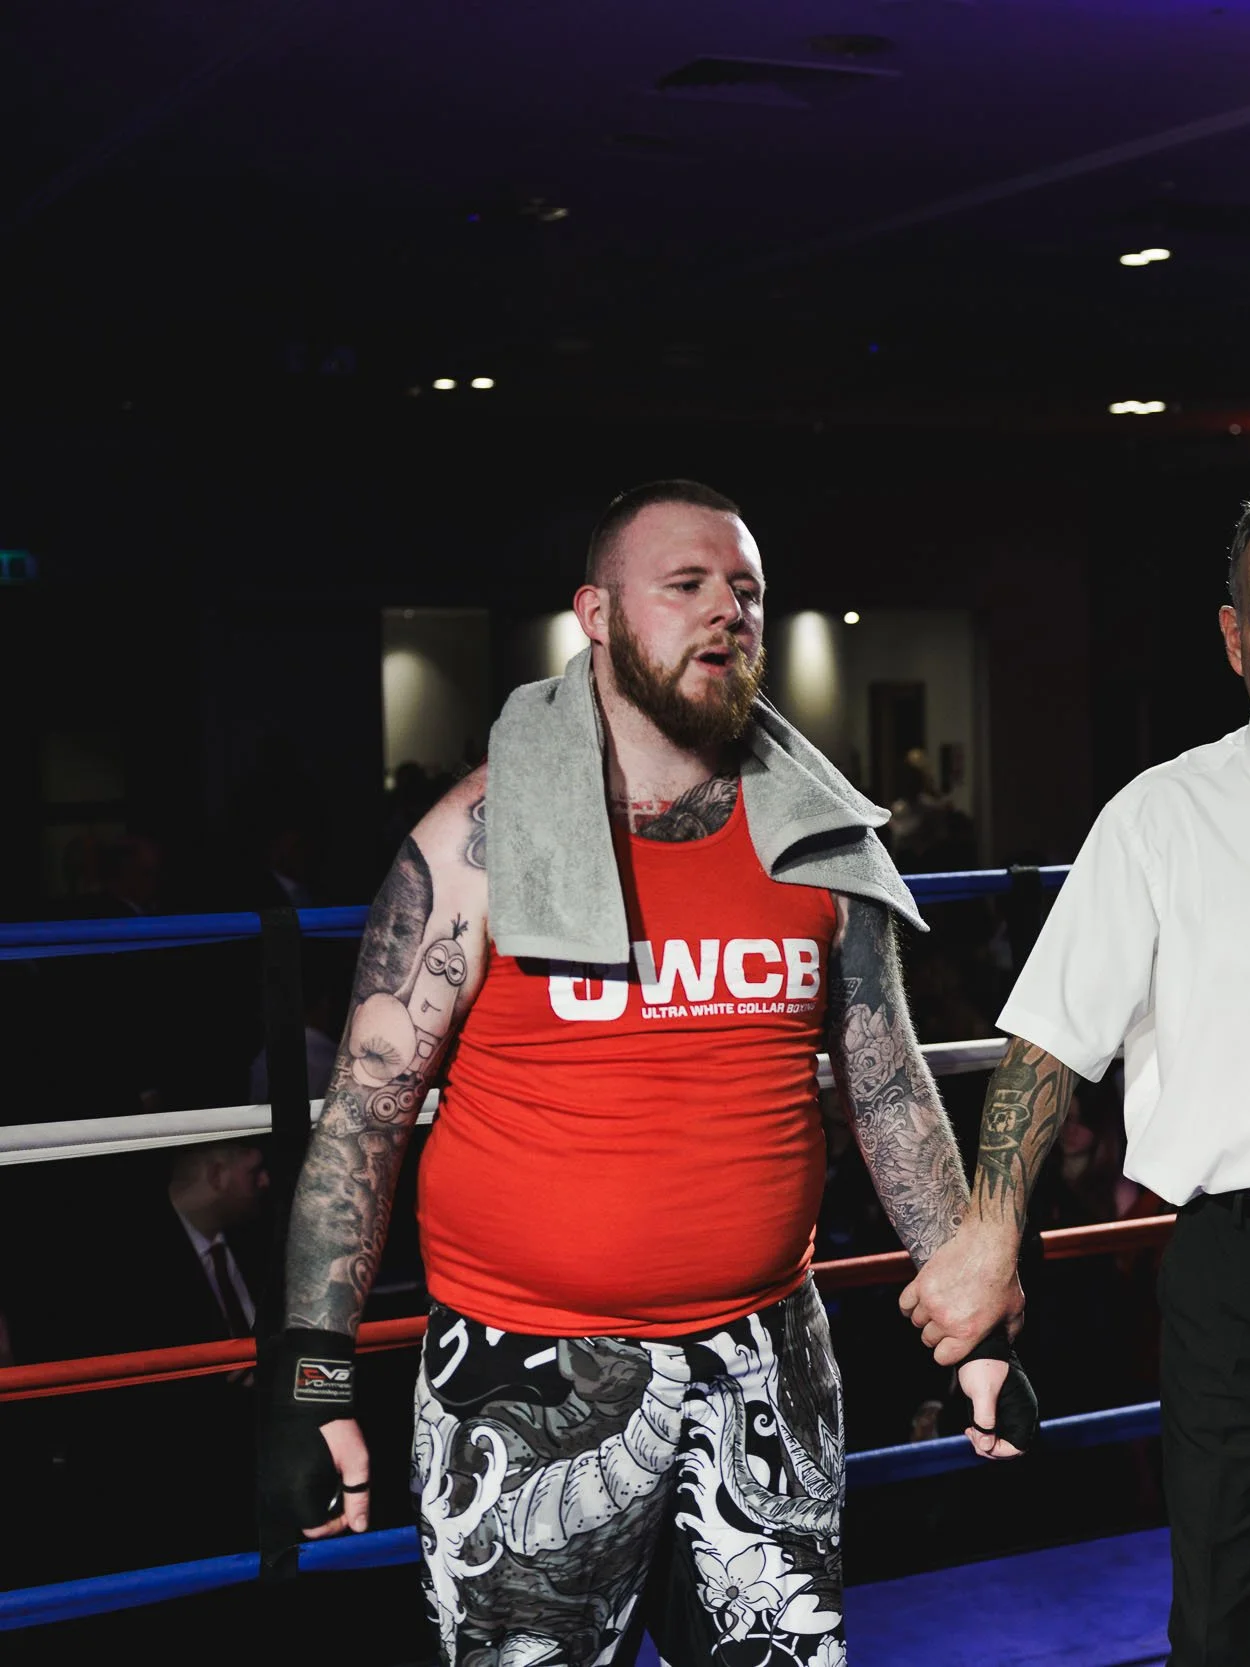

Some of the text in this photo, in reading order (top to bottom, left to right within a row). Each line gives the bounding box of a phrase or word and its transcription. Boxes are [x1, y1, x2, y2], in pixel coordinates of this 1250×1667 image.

[641, 1005, 688, 1019] ULTRA
[690, 1003, 734, 1016] WHITE
[737, 1003, 784, 1014] COLLAR
